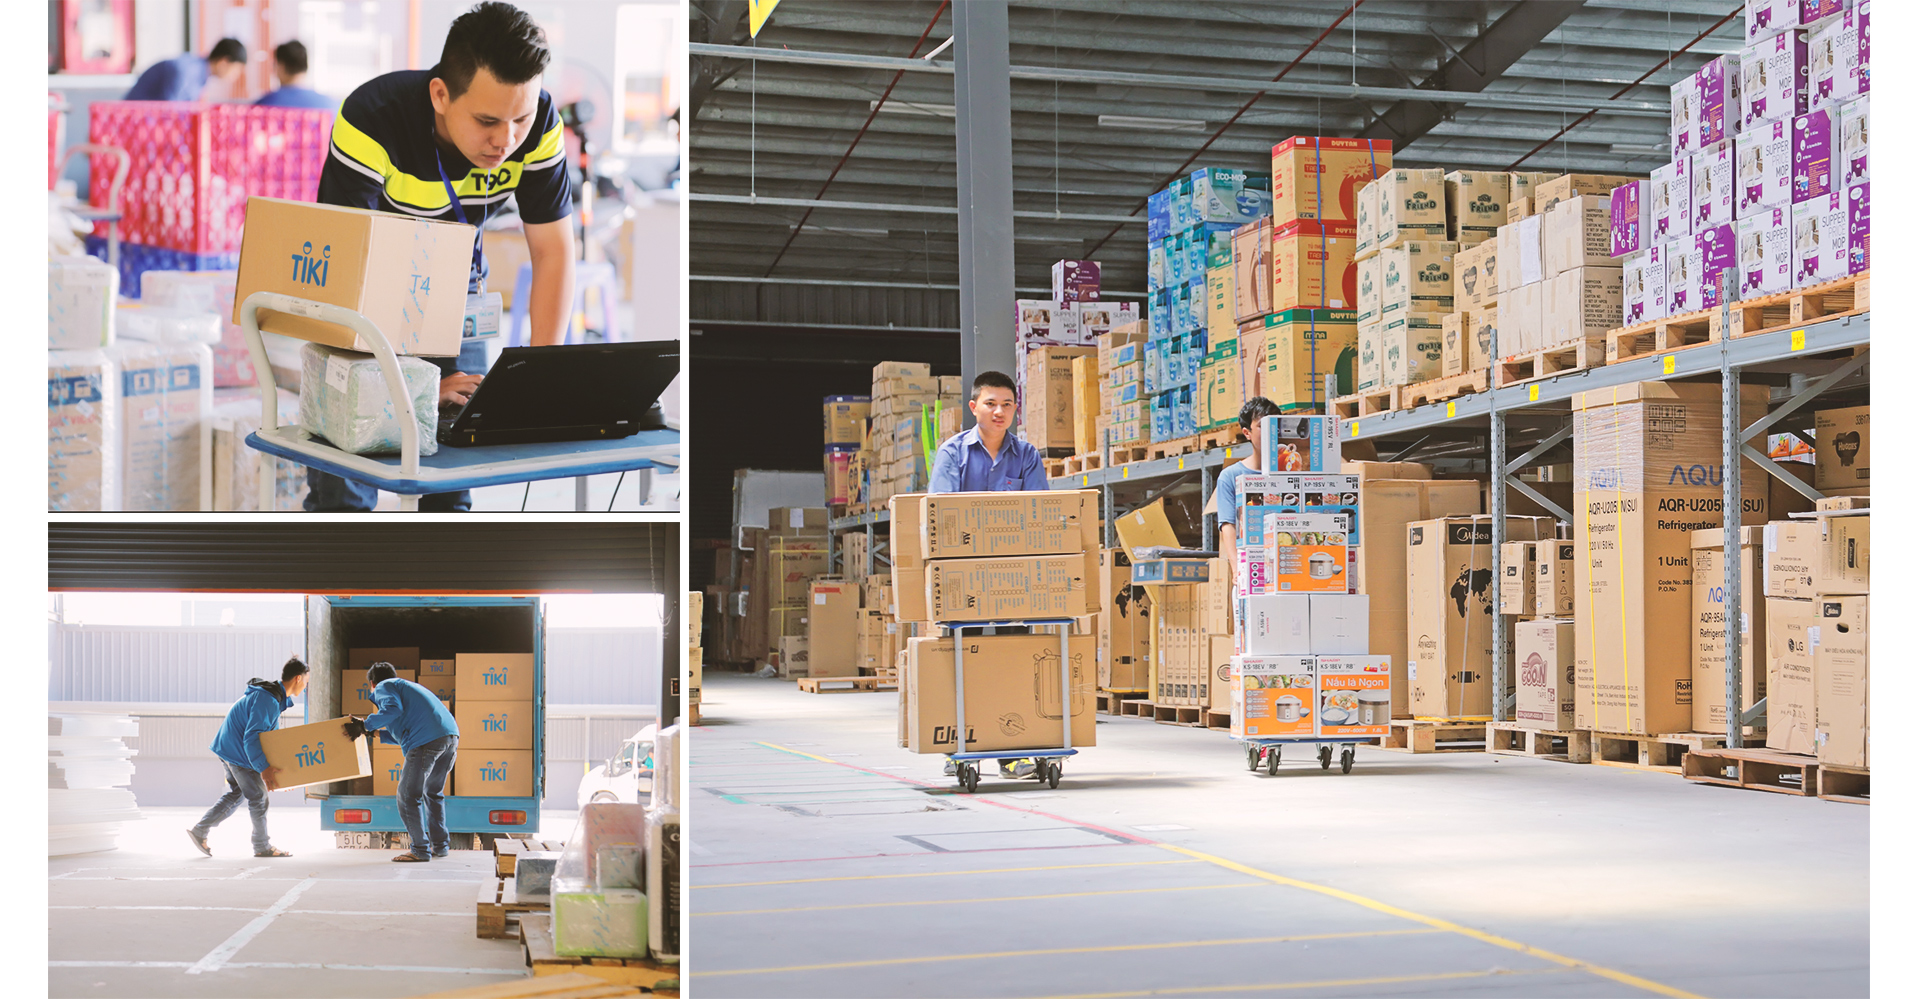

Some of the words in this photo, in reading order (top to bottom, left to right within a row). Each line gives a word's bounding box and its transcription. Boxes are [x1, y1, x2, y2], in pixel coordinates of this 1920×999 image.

[1836, 28, 1858, 47] SUPPER
[1769, 51, 1792, 69] SUPPER
[1846, 54, 1858, 69] MOP
[1775, 65, 1791, 79] PRICE
[1779, 76, 1792, 90] MOP
[1766, 140, 1789, 156] SUPPER
[1772, 152, 1789, 166] PRICE
[1713, 160, 1730, 176] SUPPER
[1776, 165, 1789, 177] MOP
[1215, 172, 1247, 181] ECO-MOP
[1671, 176, 1687, 191] SUPPER
[1405, 199, 1436, 211] FRIEND
[1469, 201, 1500, 213] FRIEND
[1822, 211, 1846, 228] SUPPER
[1765, 228, 1788, 243] SUPPER
[1828, 224, 1846, 238] PRICE
[1772, 239, 1788, 252] PRICE
[1832, 236, 1846, 250] MOP
[291, 241, 331, 287] TIKI
[1775, 252, 1788, 264] MOP
[1418, 271, 1449, 282] FRIEND
[1645, 264, 1663, 278] SUPPER
[1653, 286, 1663, 297] MOP
[1312, 447, 1320, 467] Ngon
[1590, 467, 1624, 489] AQUA
[1658, 520, 1717, 532] Refrigerator
[1665, 556, 1688, 567] Unit
[430, 662, 444, 672] TIKI
[482, 667, 508, 686] TIKI
[1326, 677, 1346, 687] Nấu
[1348, 678, 1356, 686] là
[1358, 678, 1384, 688] Ngon
[482, 713, 508, 732] TIKI
[295, 741, 326, 768] TIKI
[479, 761, 508, 781] TIKI
